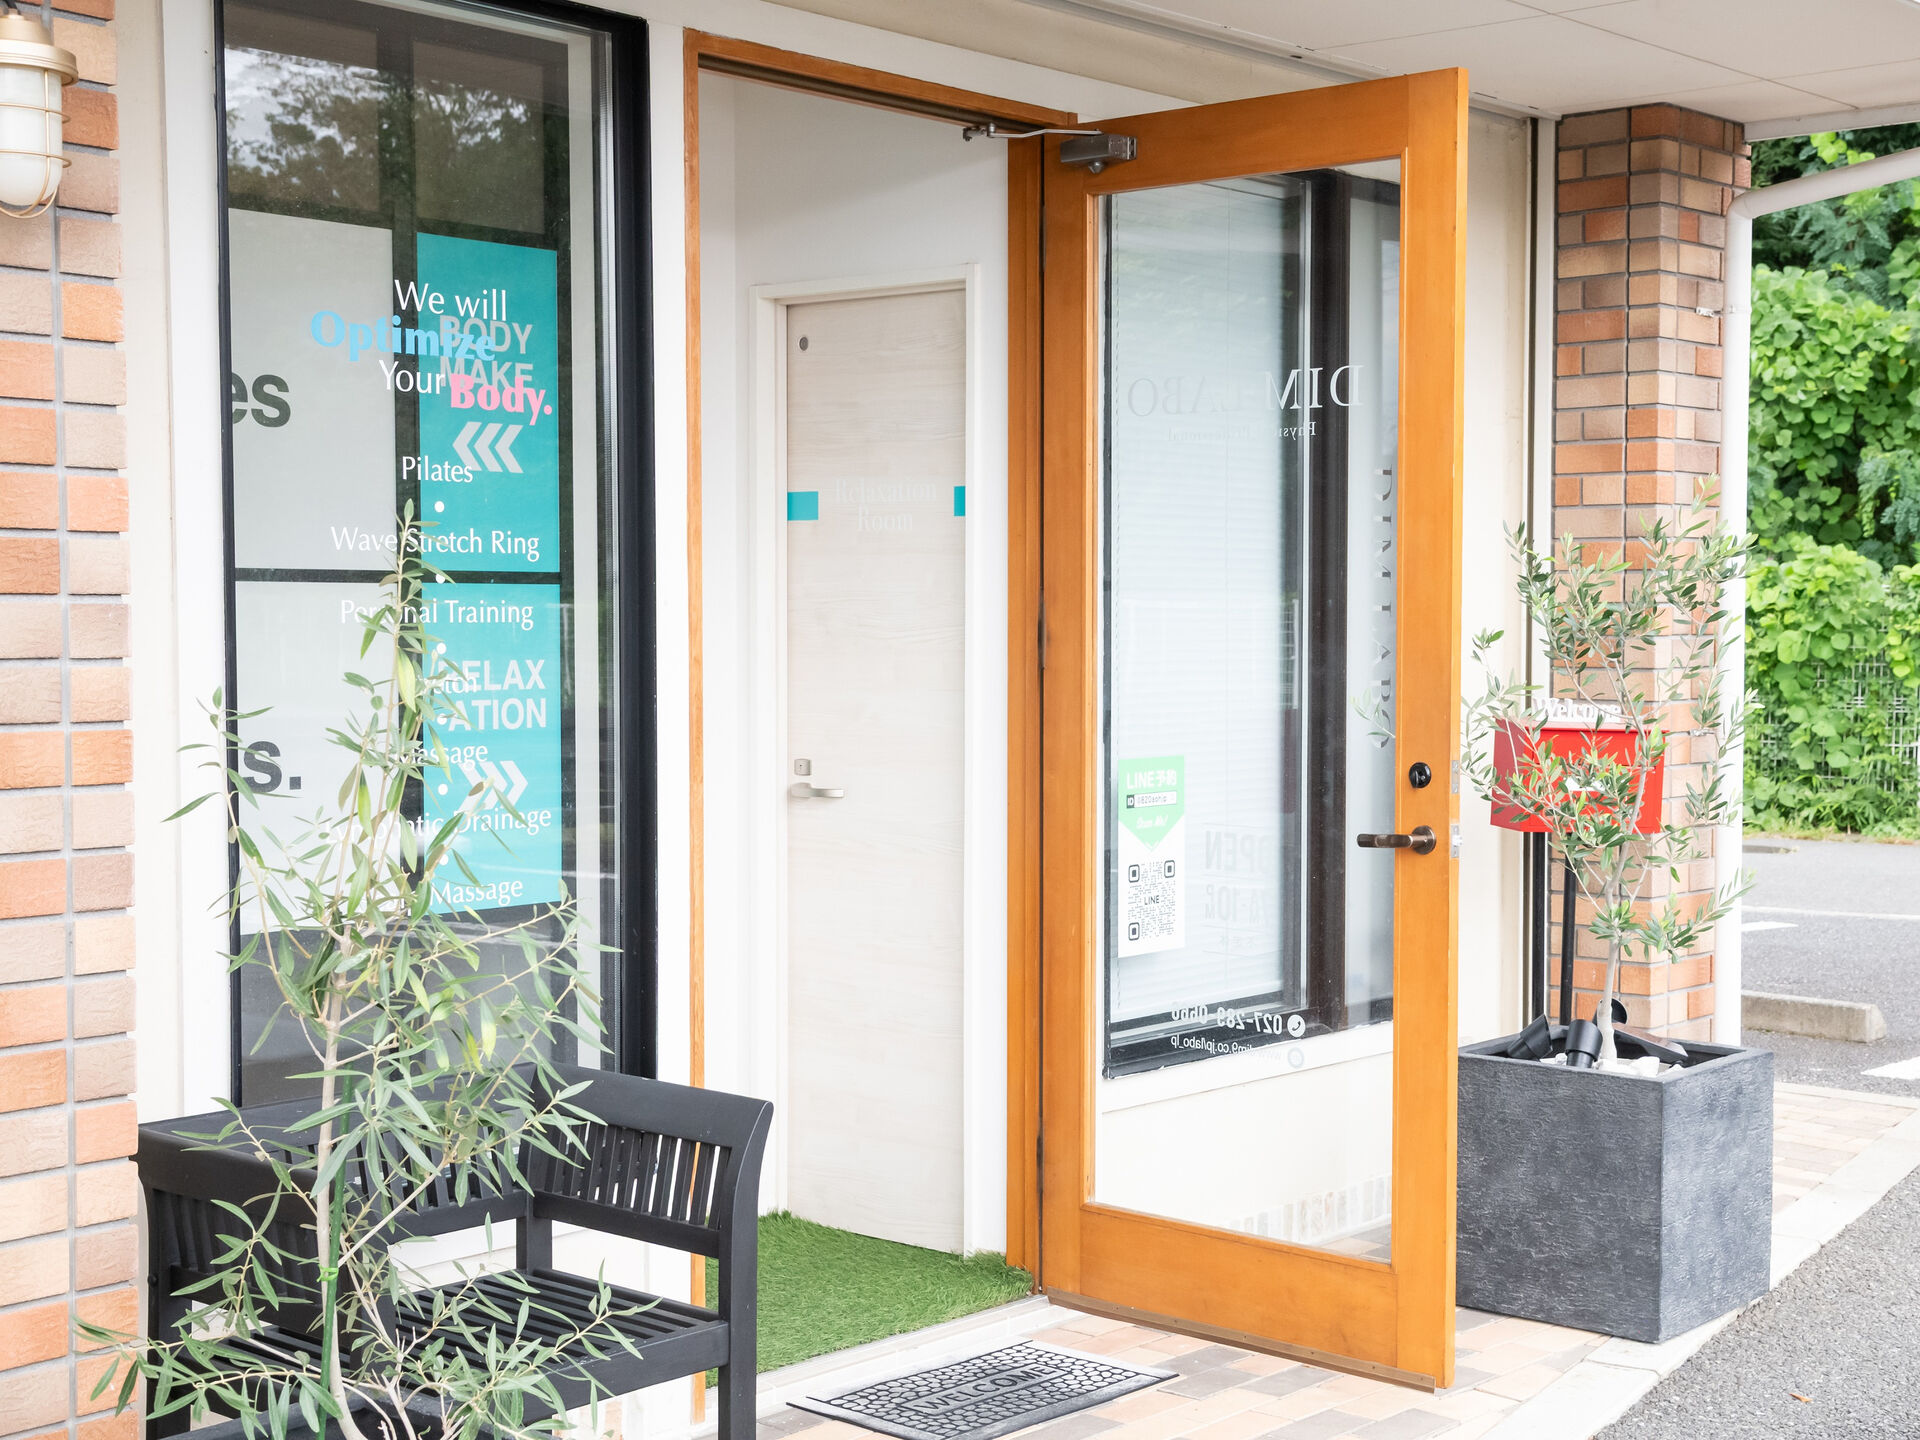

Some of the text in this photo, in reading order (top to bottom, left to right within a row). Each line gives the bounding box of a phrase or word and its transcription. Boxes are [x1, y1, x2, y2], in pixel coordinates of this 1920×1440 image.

[394, 279, 508, 322] We will
[310, 309, 496, 362] Optimize
[439, 314, 534, 355] BODY
[378, 359, 553, 426] Your Body.
[401, 455, 474, 483] Pilates
[330, 526, 541, 563] Wave Stretch Ring
[341, 597, 534, 631] Pernal Training
[448, 697, 547, 732] ATION
[452, 806, 552, 836] Drainage
[430, 879, 524, 906] Massage
[1143, 894, 1160, 906] LINE
[914, 1365, 1058, 1411] WELCOME
